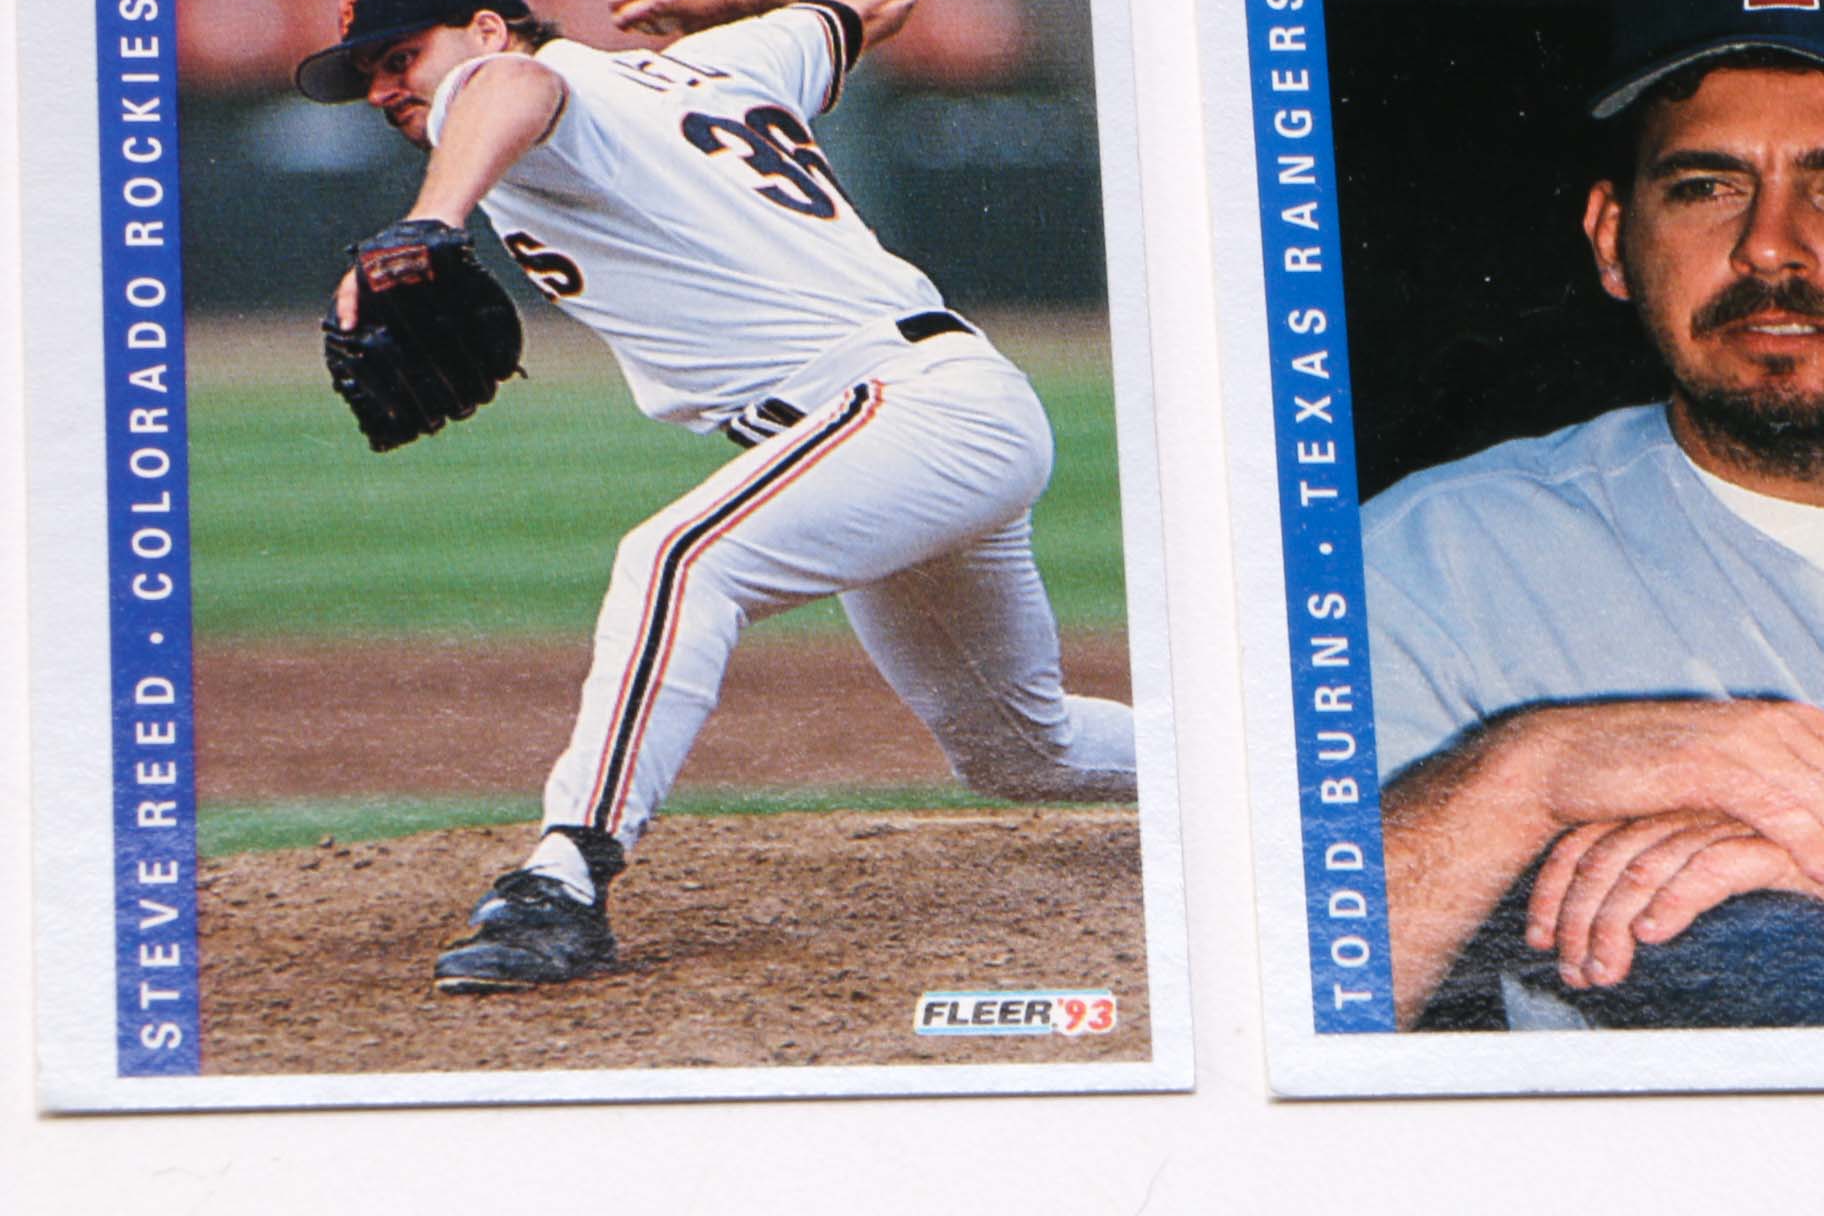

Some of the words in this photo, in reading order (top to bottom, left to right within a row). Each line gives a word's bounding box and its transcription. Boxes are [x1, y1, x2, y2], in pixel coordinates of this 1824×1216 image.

[125, 277, 173, 601] COLORADO
[1287, 308, 1338, 507] TEXAS
[134, 676, 177, 828] REED
[1307, 592, 1359, 804] BURNS
[137, 860, 183, 1051] STEVE
[922, 1000, 1053, 1026] FLEER
[1325, 841, 1373, 1010] TODD
